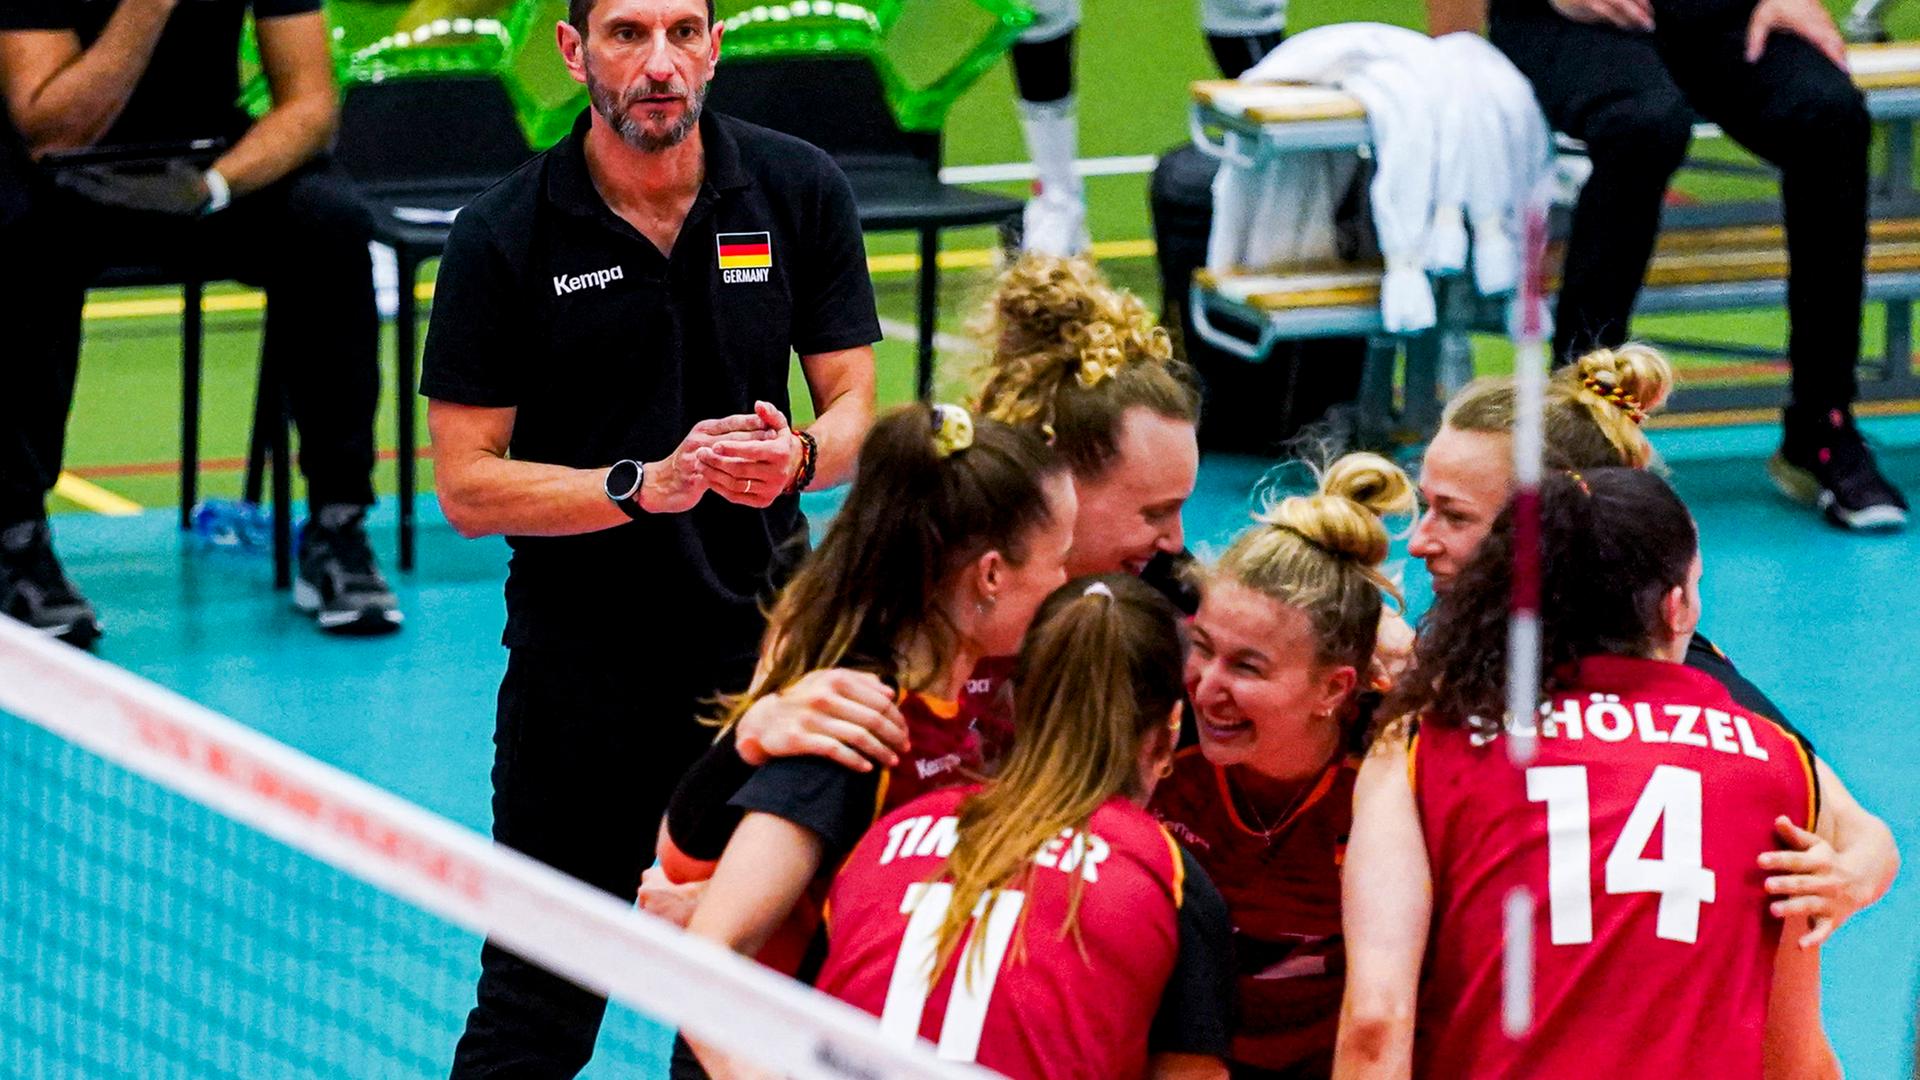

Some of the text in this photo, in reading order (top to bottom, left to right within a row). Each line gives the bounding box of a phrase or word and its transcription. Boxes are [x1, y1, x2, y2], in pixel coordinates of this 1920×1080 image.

[553, 265, 624, 296] Kempa
[723, 268, 769, 284] GERMANY
[879, 815, 1111, 884] TIMER
[1526, 764, 1716, 945] 14
[880, 882, 1025, 1064] 11
